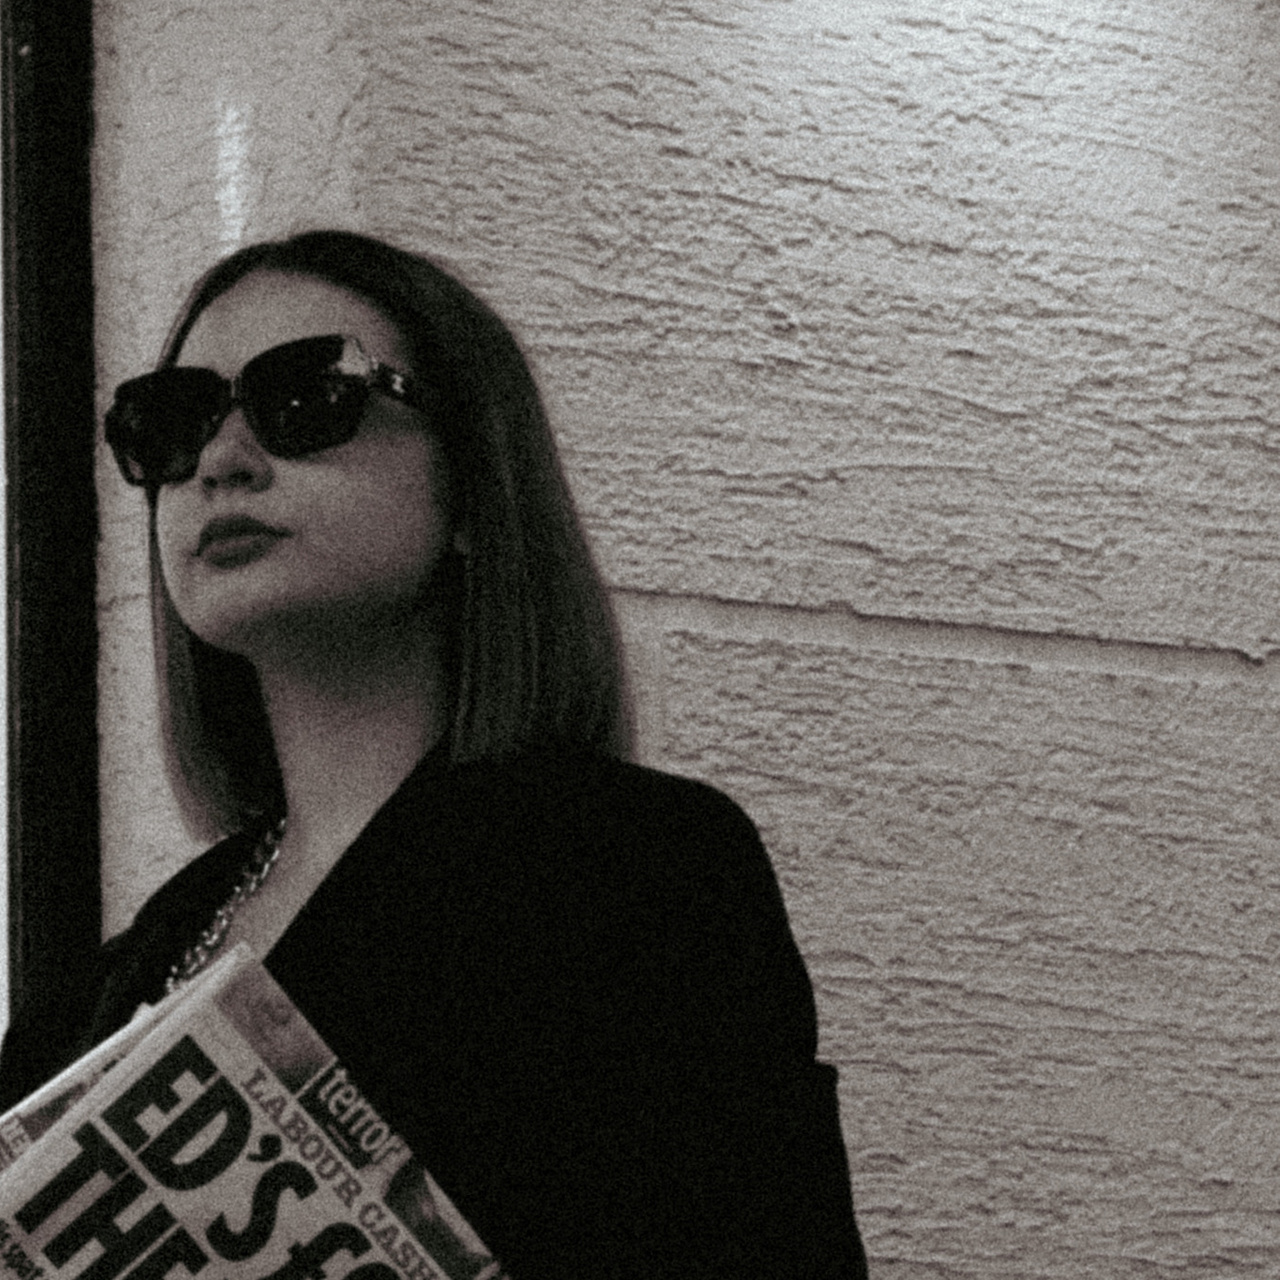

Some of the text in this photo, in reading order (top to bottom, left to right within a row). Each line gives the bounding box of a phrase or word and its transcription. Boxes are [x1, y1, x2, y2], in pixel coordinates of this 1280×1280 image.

[99, 1033, 319, 1263] ED'S
[240, 1067, 363, 1208] LABOUR
[317, 1067, 408, 1166] terror
